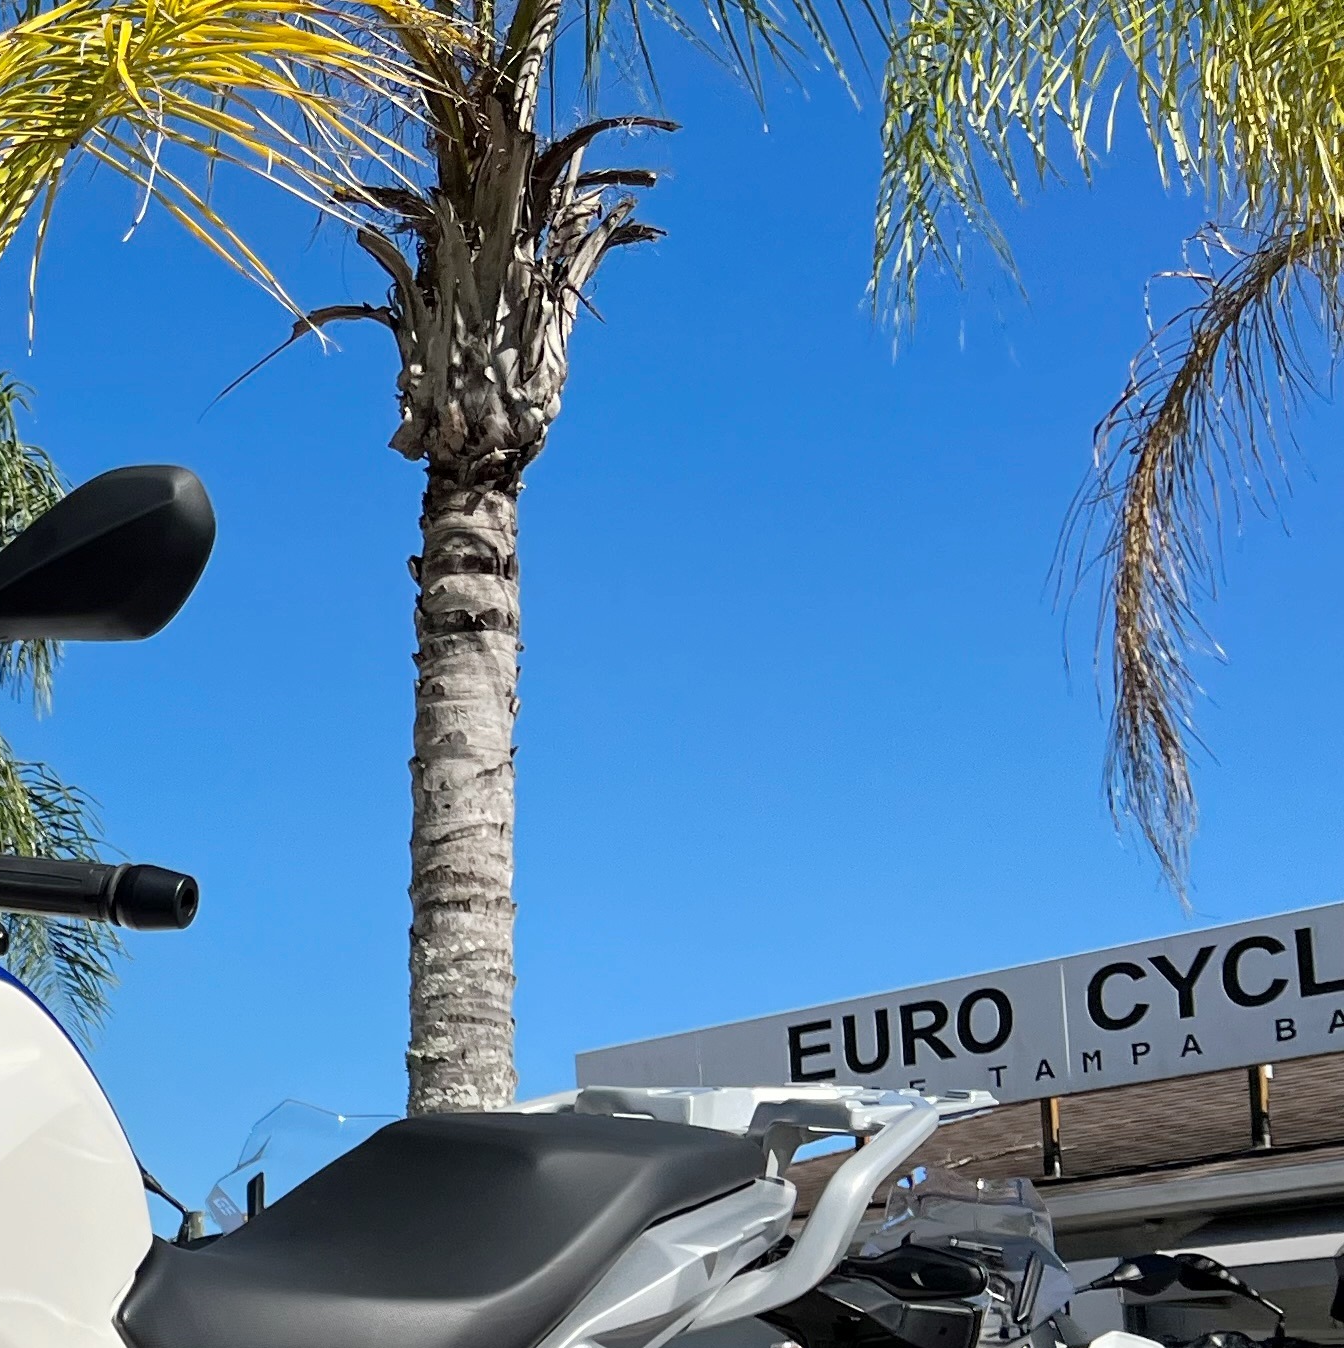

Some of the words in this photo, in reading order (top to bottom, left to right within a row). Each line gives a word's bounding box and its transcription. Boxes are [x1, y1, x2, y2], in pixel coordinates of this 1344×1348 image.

[786, 987, 1014, 1083] EURO
[1084, 927, 1344, 1032] CYCL
[987, 1032, 1205, 1090] TAMPA
